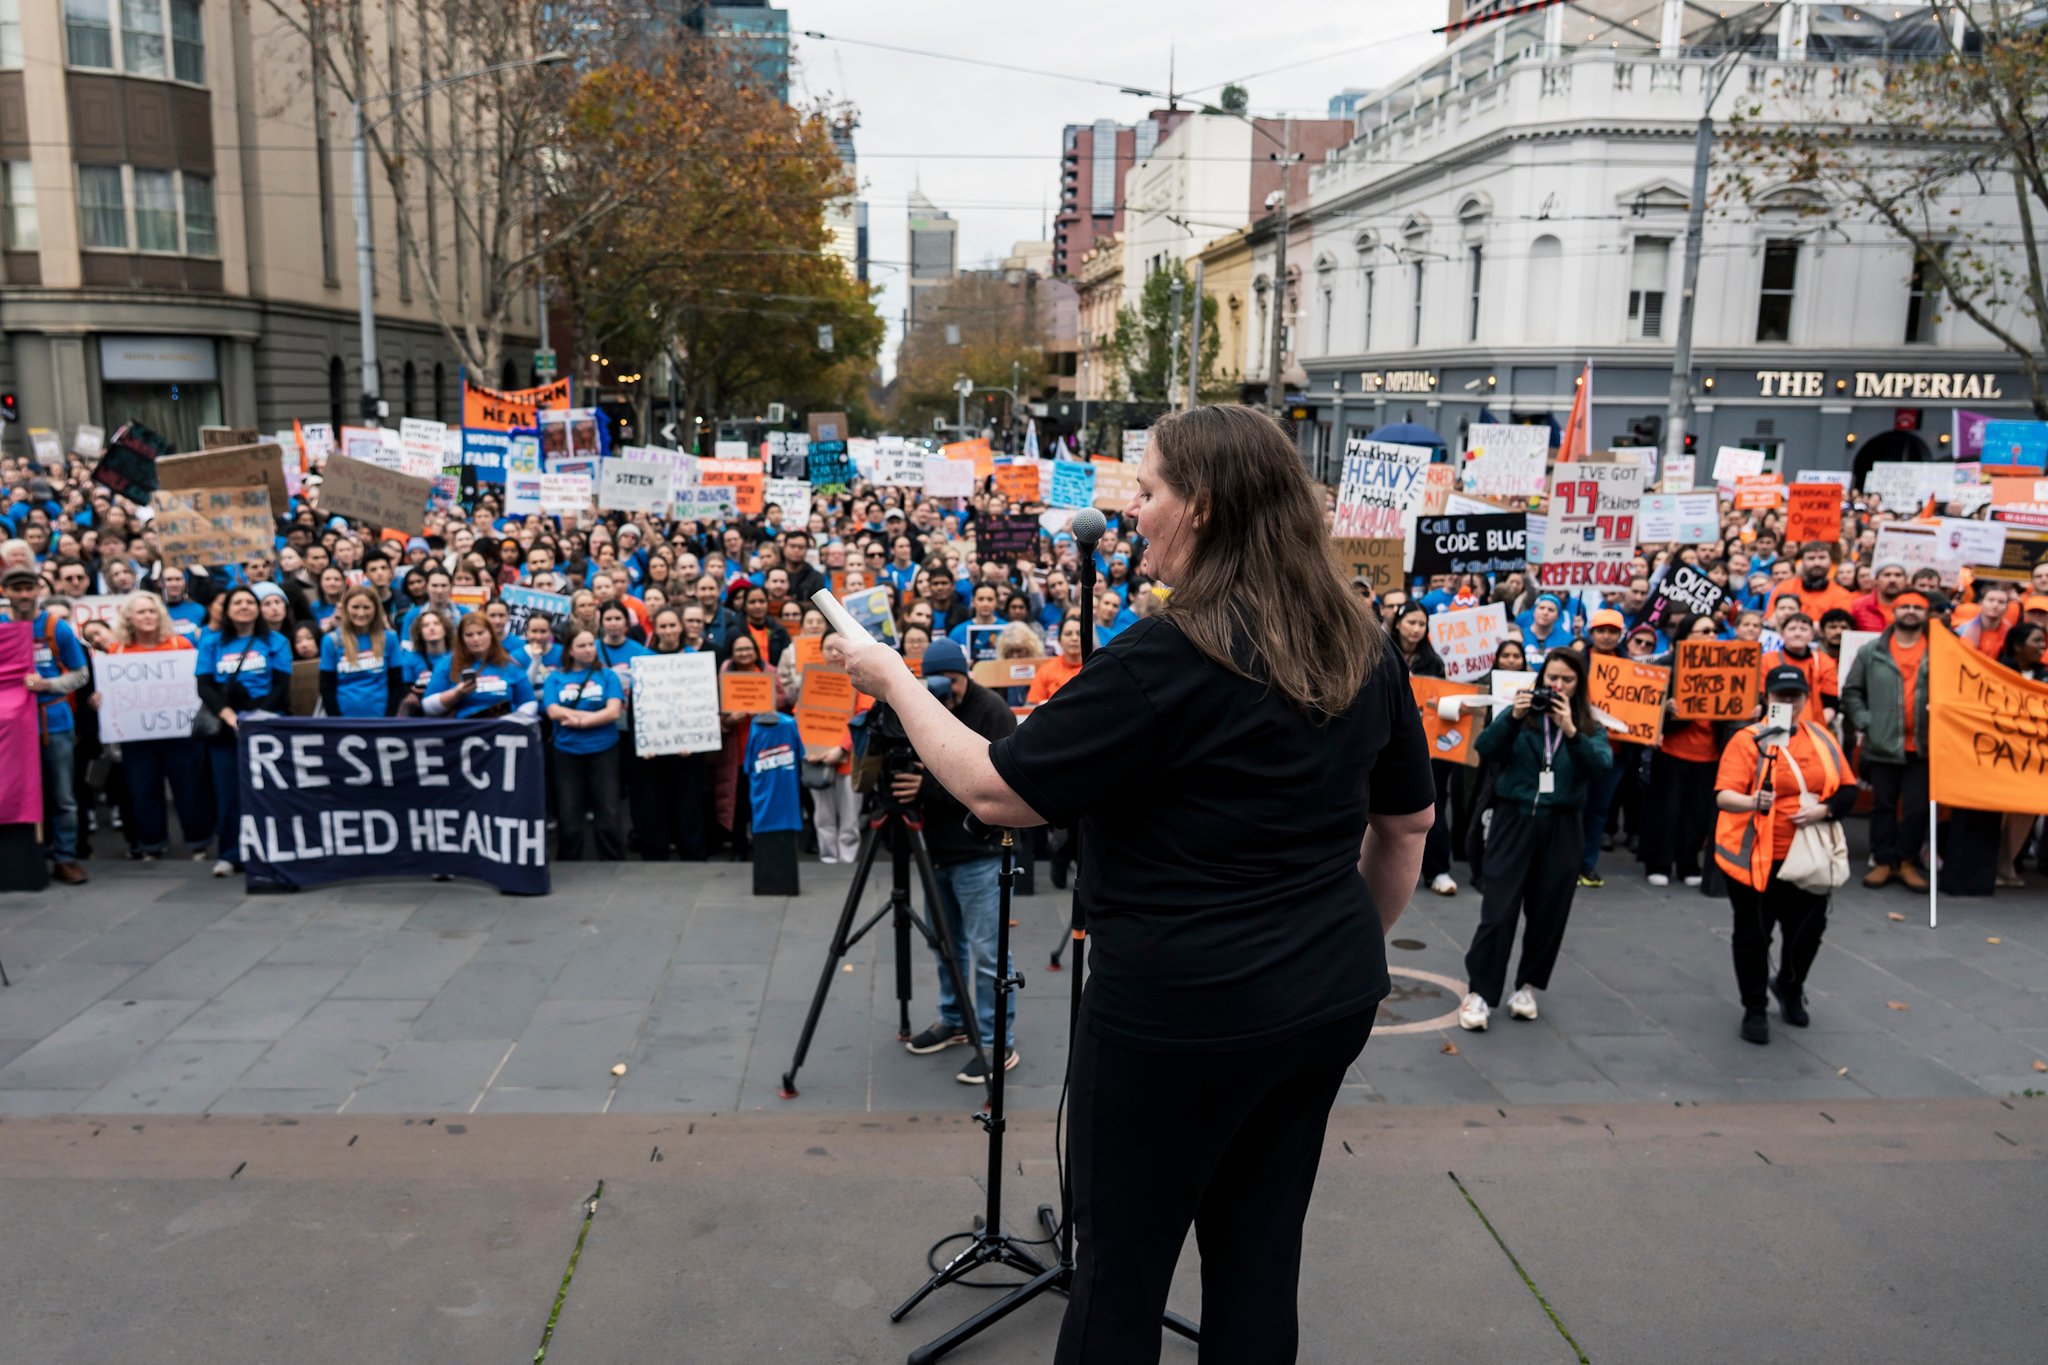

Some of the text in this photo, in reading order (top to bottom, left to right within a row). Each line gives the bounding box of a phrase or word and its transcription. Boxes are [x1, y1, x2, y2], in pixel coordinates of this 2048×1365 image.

[1385, 372, 1433, 392] IMPERIAL
[1756, 371, 2002, 399] THE IMPERIAL
[1347, 458, 1420, 492] HEAVY
[1610, 466, 1638, 481] GOT
[1361, 491, 1396, 510] needs
[1555, 480, 1599, 515] 99
[1336, 502, 1405, 534] MANUAL
[1419, 517, 1451, 535] Call
[1455, 518, 1467, 533] a
[1596, 515, 1635, 541] 90
[1434, 529, 1528, 555] CODE BLUE
[1351, 561, 1392, 590] THIS
[1541, 560, 1634, 588] REFERRALS
[1673, 566, 1723, 608] OVER
[1436, 620, 1471, 643] FAIR
[1682, 644, 1759, 669] HEALTHCARE
[1596, 662, 1620, 683] NO
[1730, 674, 1747, 694] IN
[1604, 681, 1667, 706] SCIENTIST
[1681, 695, 1744, 716] THE LAB
[140, 708, 172, 733] US
[246, 733, 530, 794] RESPECT
[238, 807, 547, 868] ALLIED HEALTH
